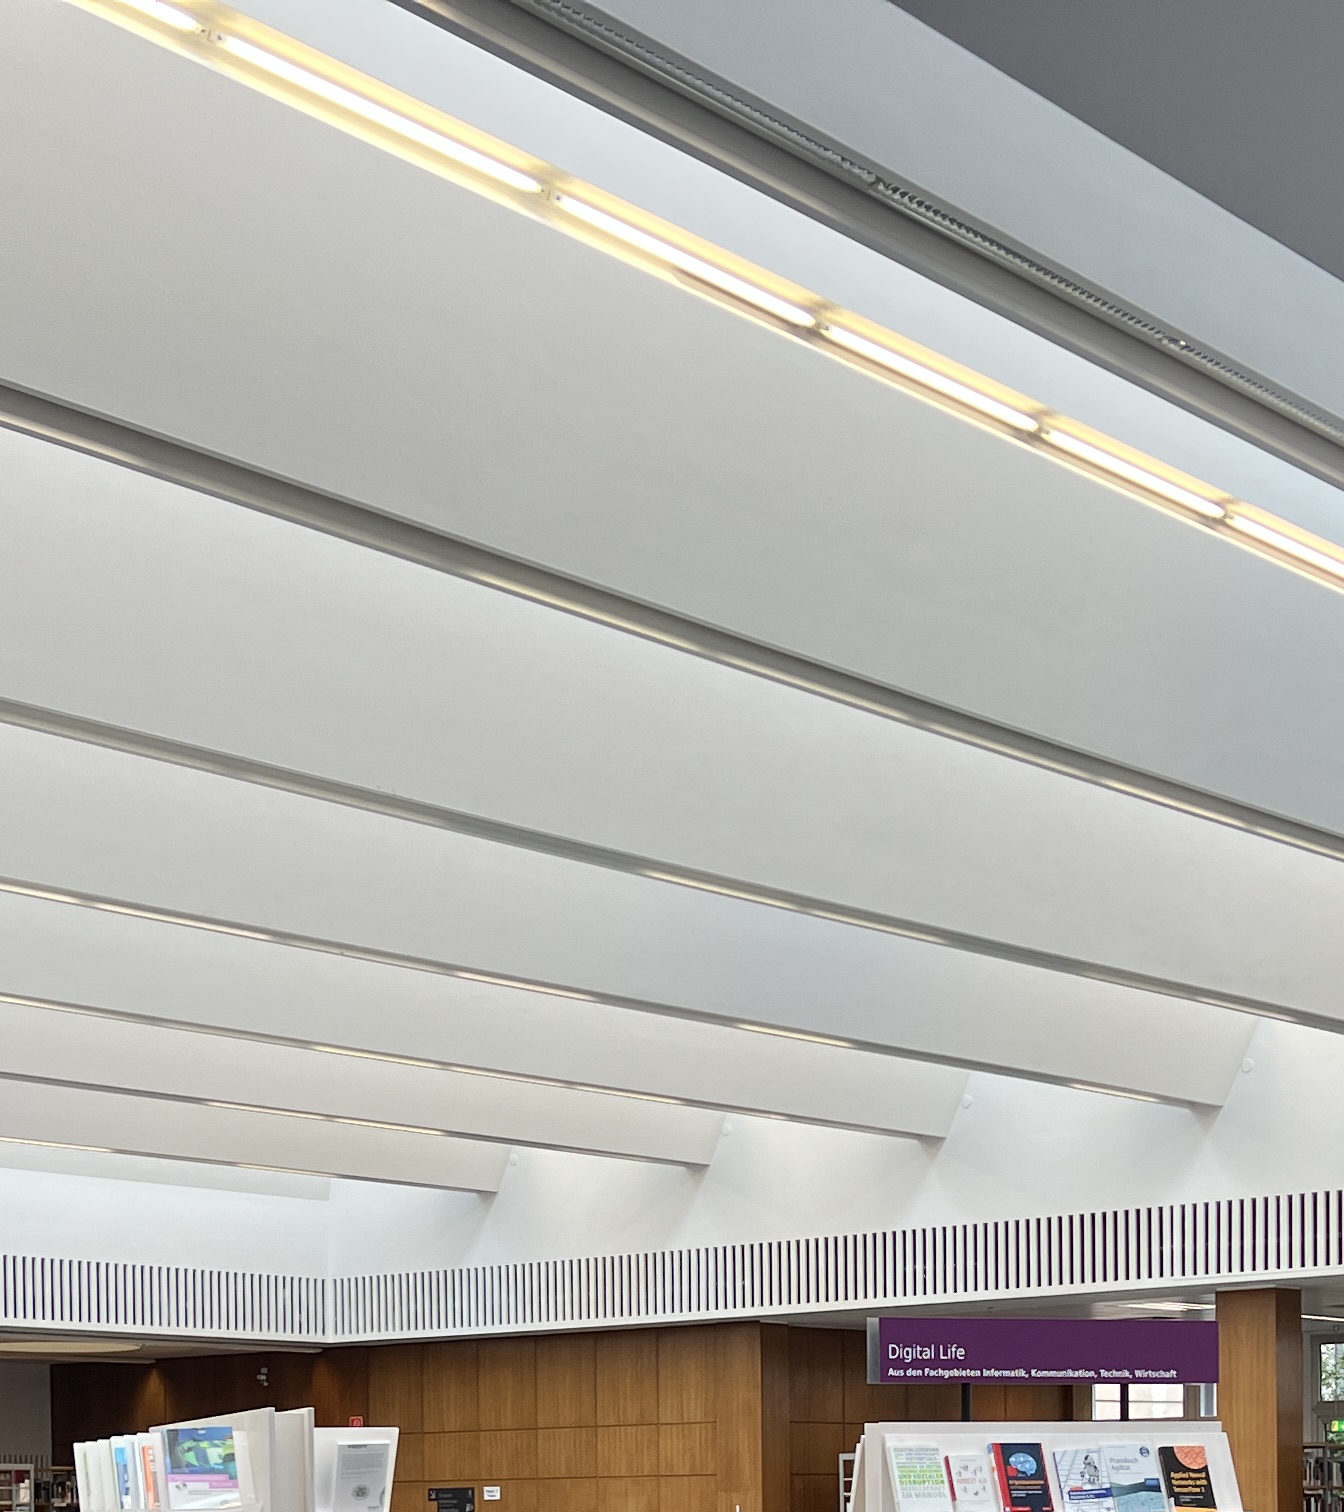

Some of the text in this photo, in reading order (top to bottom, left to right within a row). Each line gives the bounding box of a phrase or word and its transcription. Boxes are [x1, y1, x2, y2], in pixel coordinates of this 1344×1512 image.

[888, 1343, 966, 1363] Digital Life
[888, 1367, 1178, 1380] Aus den Fachgebieten Informatik, Kommunikation, Technik, Wirtschaft
